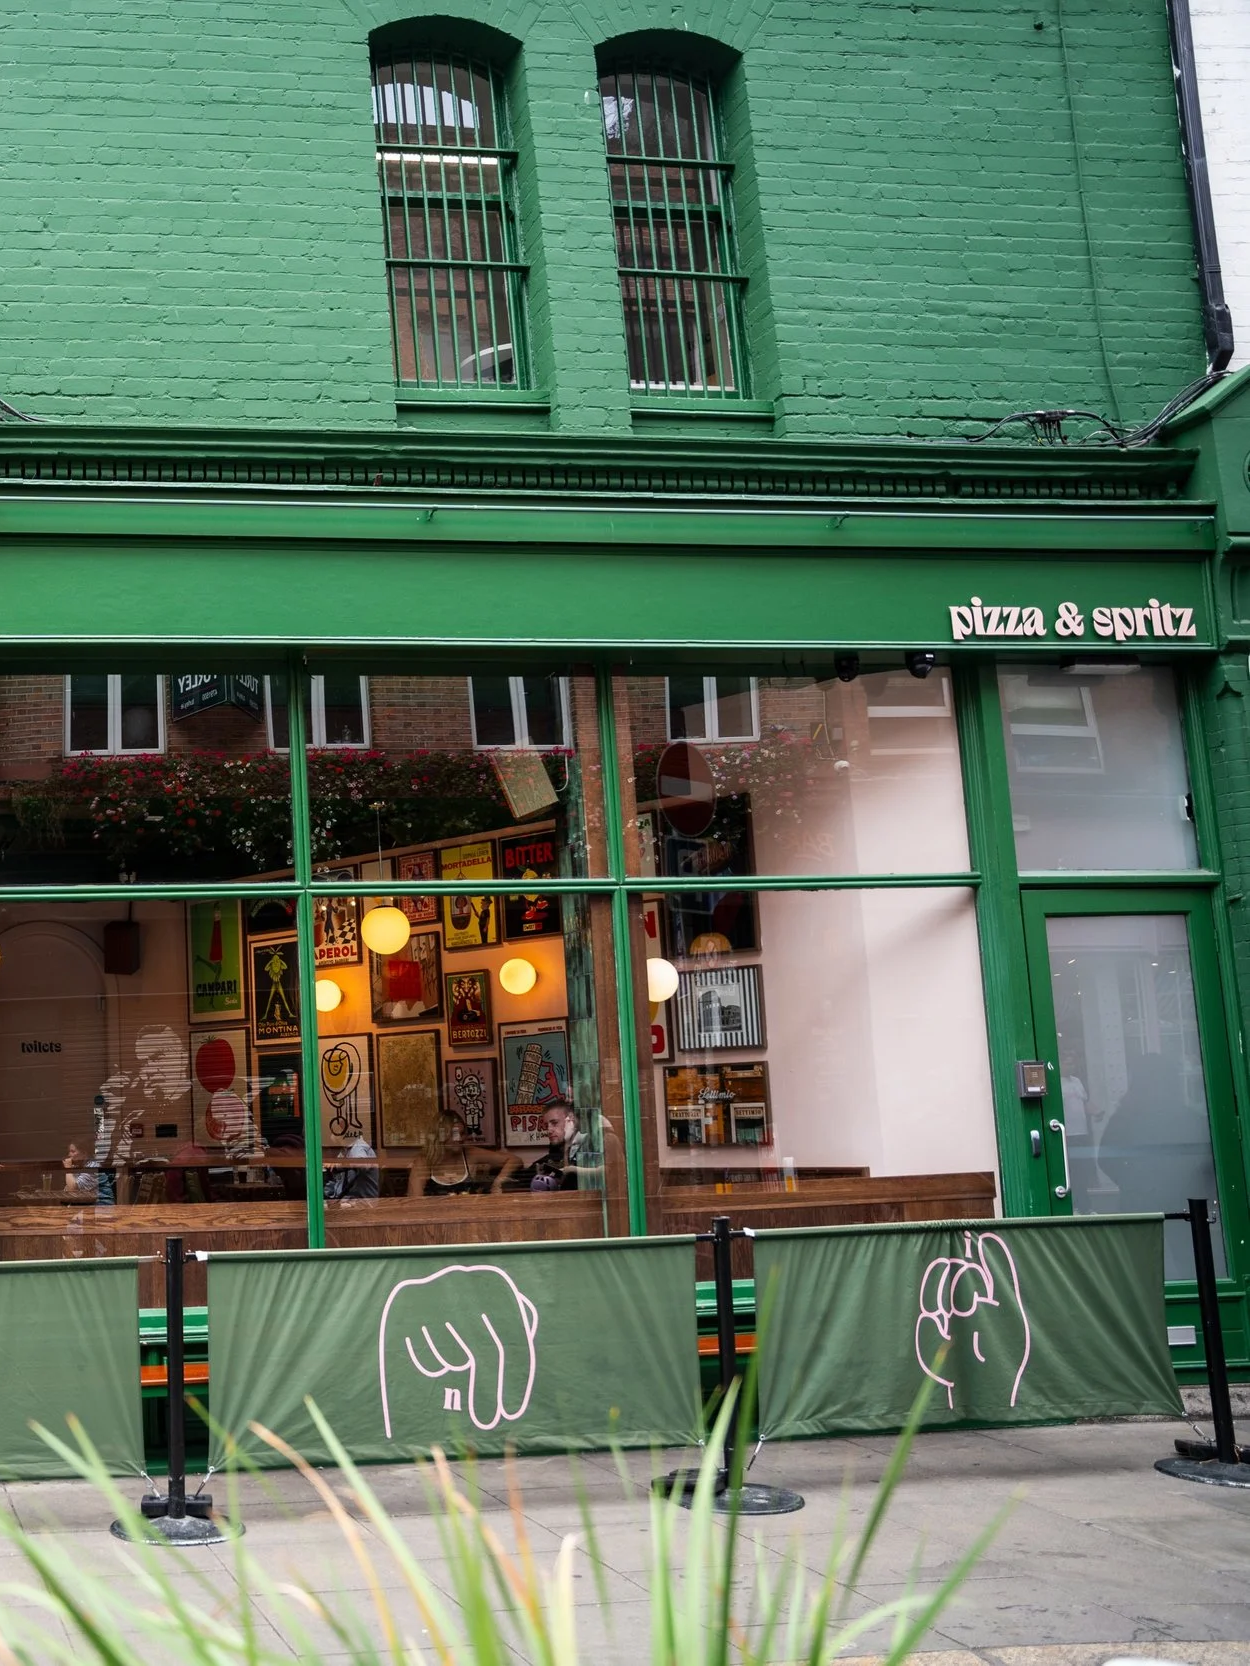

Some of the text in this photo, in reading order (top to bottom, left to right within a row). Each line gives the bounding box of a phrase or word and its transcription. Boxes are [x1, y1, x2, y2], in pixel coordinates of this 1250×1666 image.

[948, 596, 1197, 642] pizza & spritz
[505, 841, 554, 869] BITTER
[441, 856, 492, 871] MORTADELLA
[196, 980, 238, 998] CAMPARI
[258, 1025, 299, 1035] MONTINA
[452, 1028, 487, 1039] BERTOZZI
[21, 1040, 62, 1053] toilets
[442, 1386, 462, 1412] n
